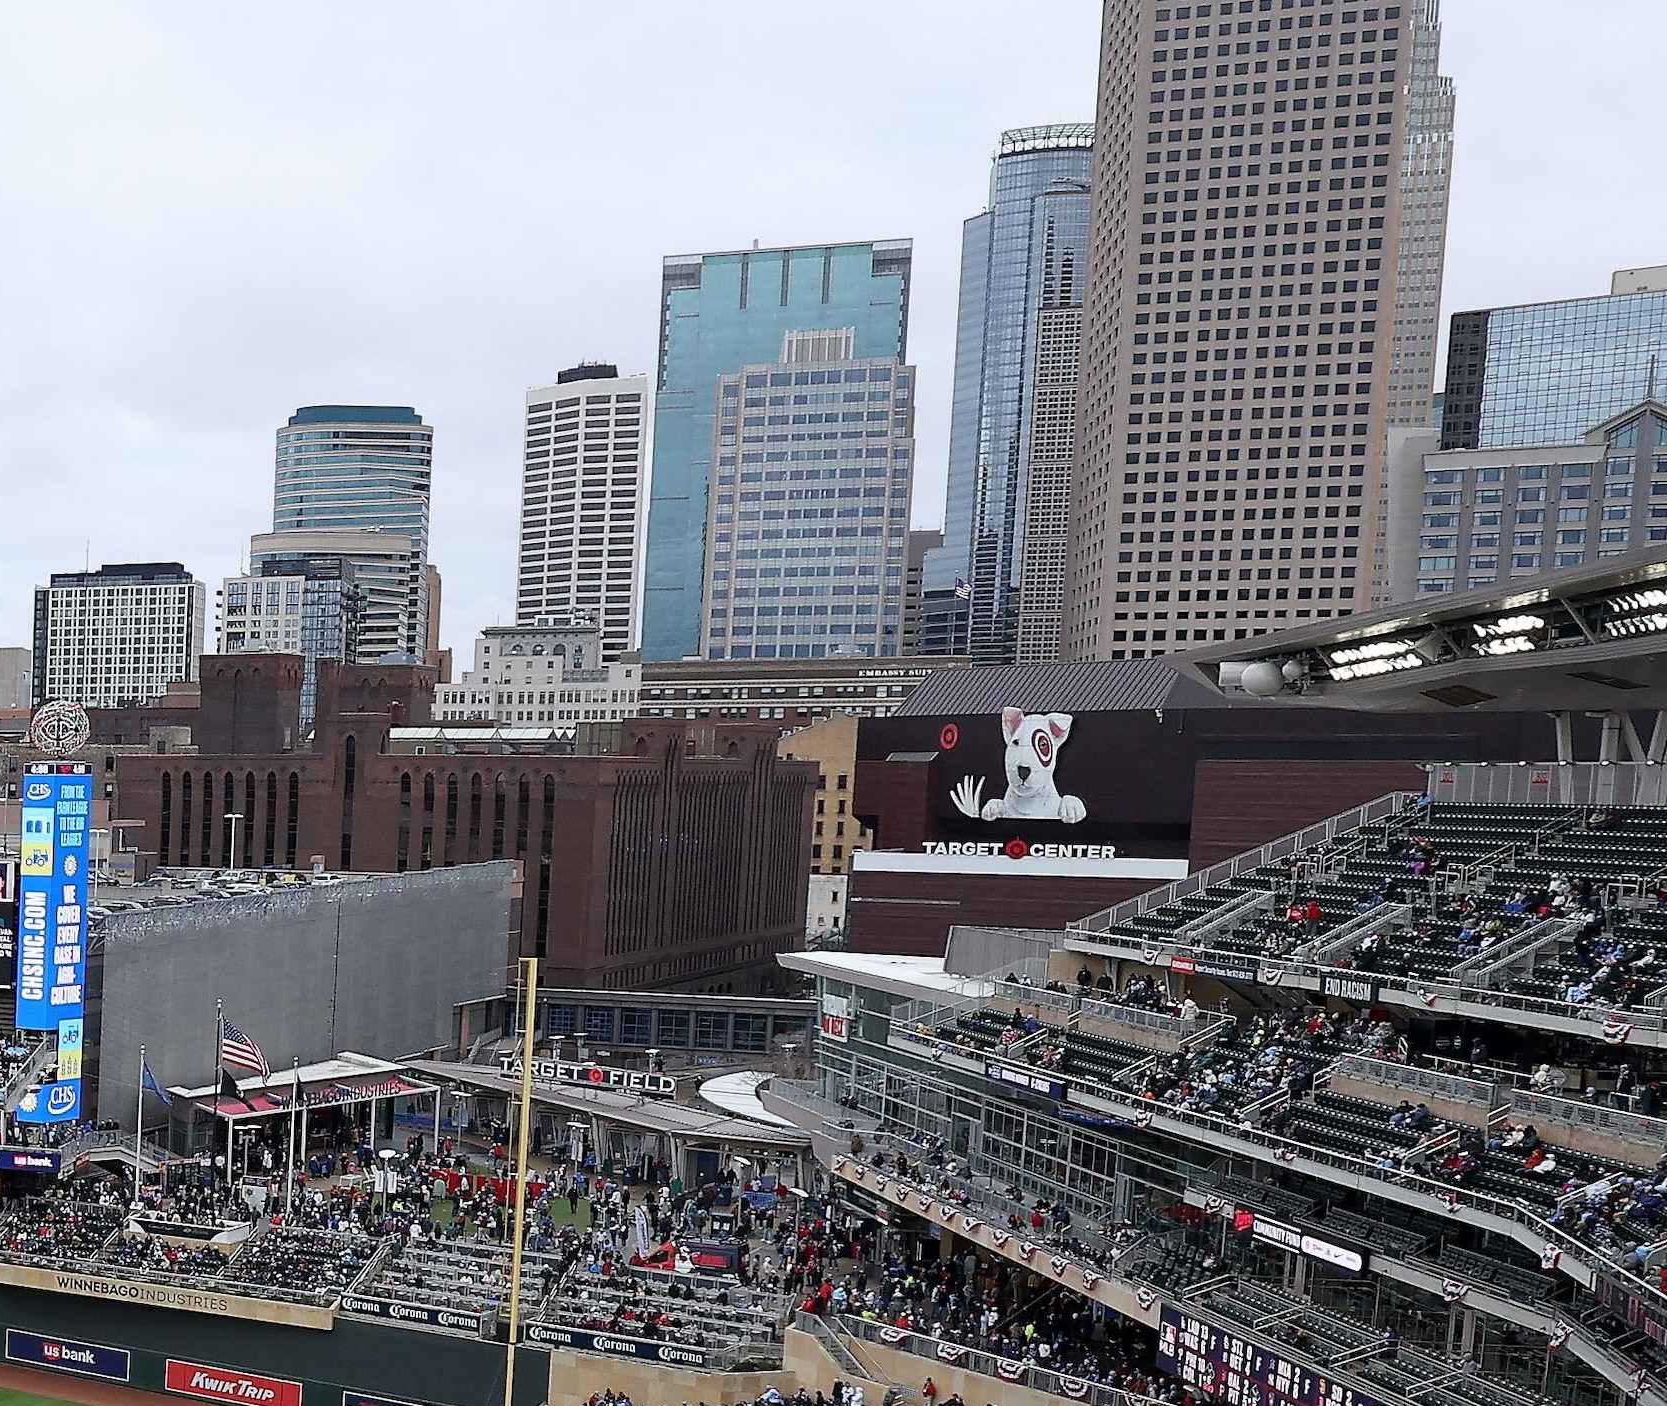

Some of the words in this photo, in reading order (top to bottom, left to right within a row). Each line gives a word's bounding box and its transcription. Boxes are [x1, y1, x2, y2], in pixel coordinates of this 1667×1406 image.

[30, 784, 49, 793] CHS
[922, 842, 1003, 856] TARGET
[1030, 844, 1116, 859] CENTER
[21, 892, 46, 1000] CHSINC.COM
[1325, 977, 1340, 995] END
[1341, 980, 1371, 1001] RACISM
[610, 1072, 675, 1092] FIELD
[51, 1085, 73, 1104] CHS
[56, 1275, 140, 1298] WINNEBAGO
[140, 1288, 228, 1311] INDUSTRIES
[343, 1296, 380, 1314] Corona
[389, 1303, 429, 1321] Corona
[437, 1311, 478, 1330] Corona
[529, 1322, 571, 1343] Corona
[593, 1335, 636, 1353] Corona
[658, 1345, 703, 1364] Corona
